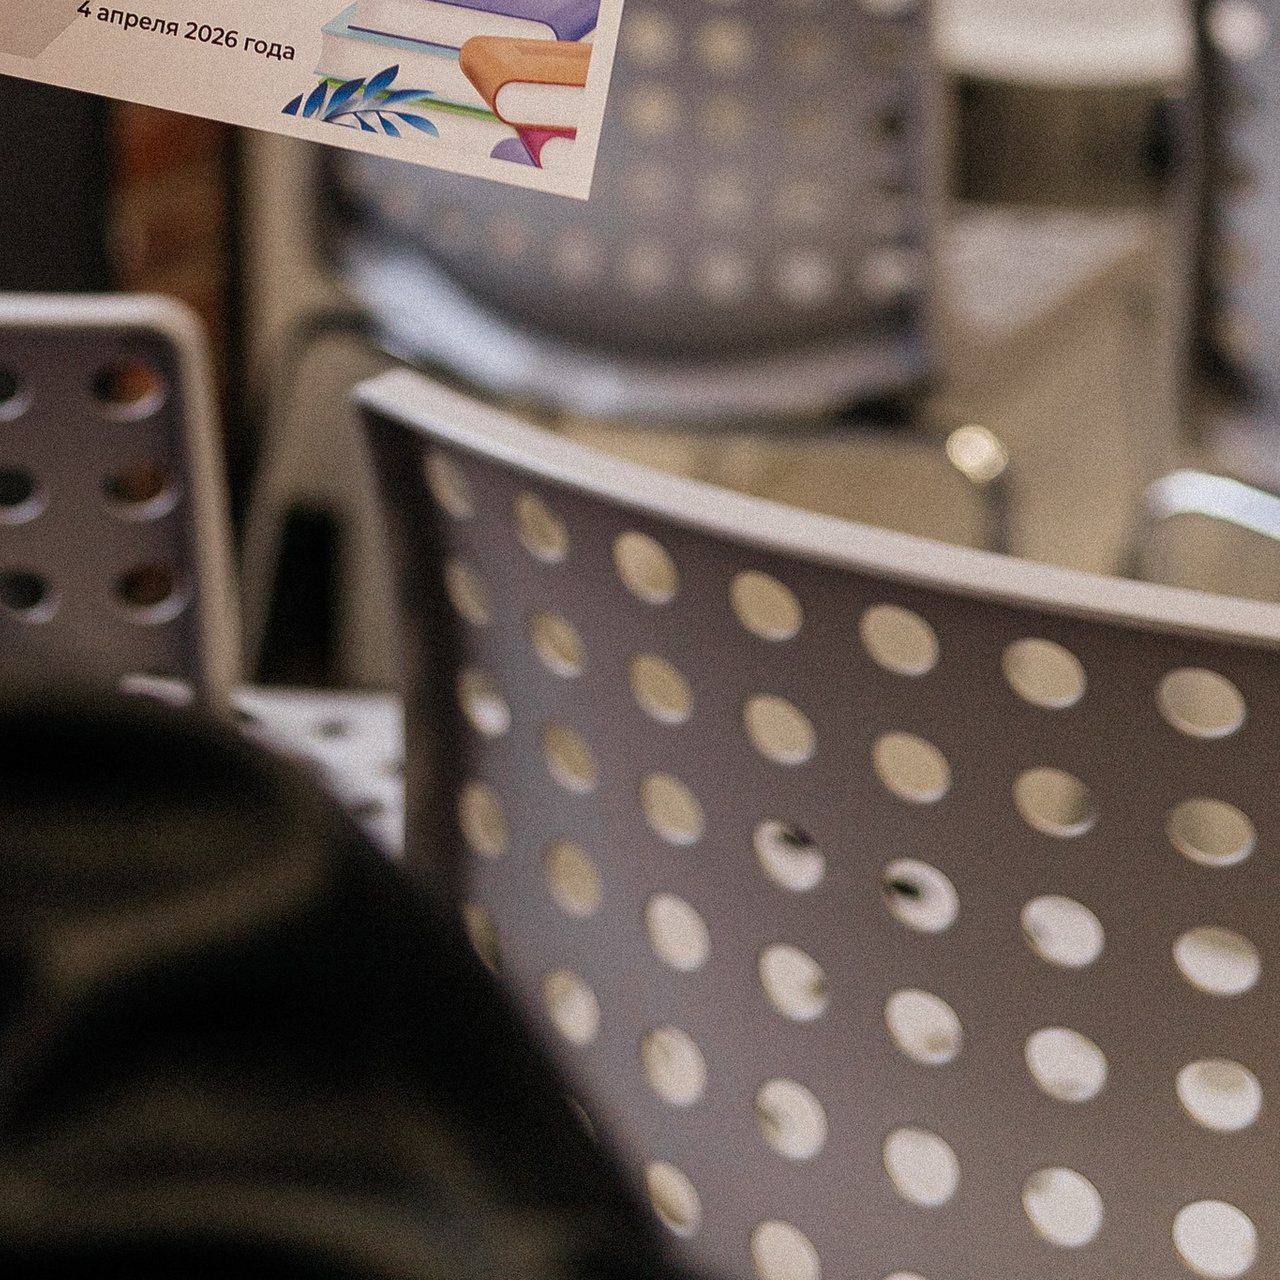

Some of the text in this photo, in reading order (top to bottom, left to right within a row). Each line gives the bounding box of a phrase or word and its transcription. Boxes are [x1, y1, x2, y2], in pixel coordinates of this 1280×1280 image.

[76, 0, 296, 62] 4 апреля 2026 года
